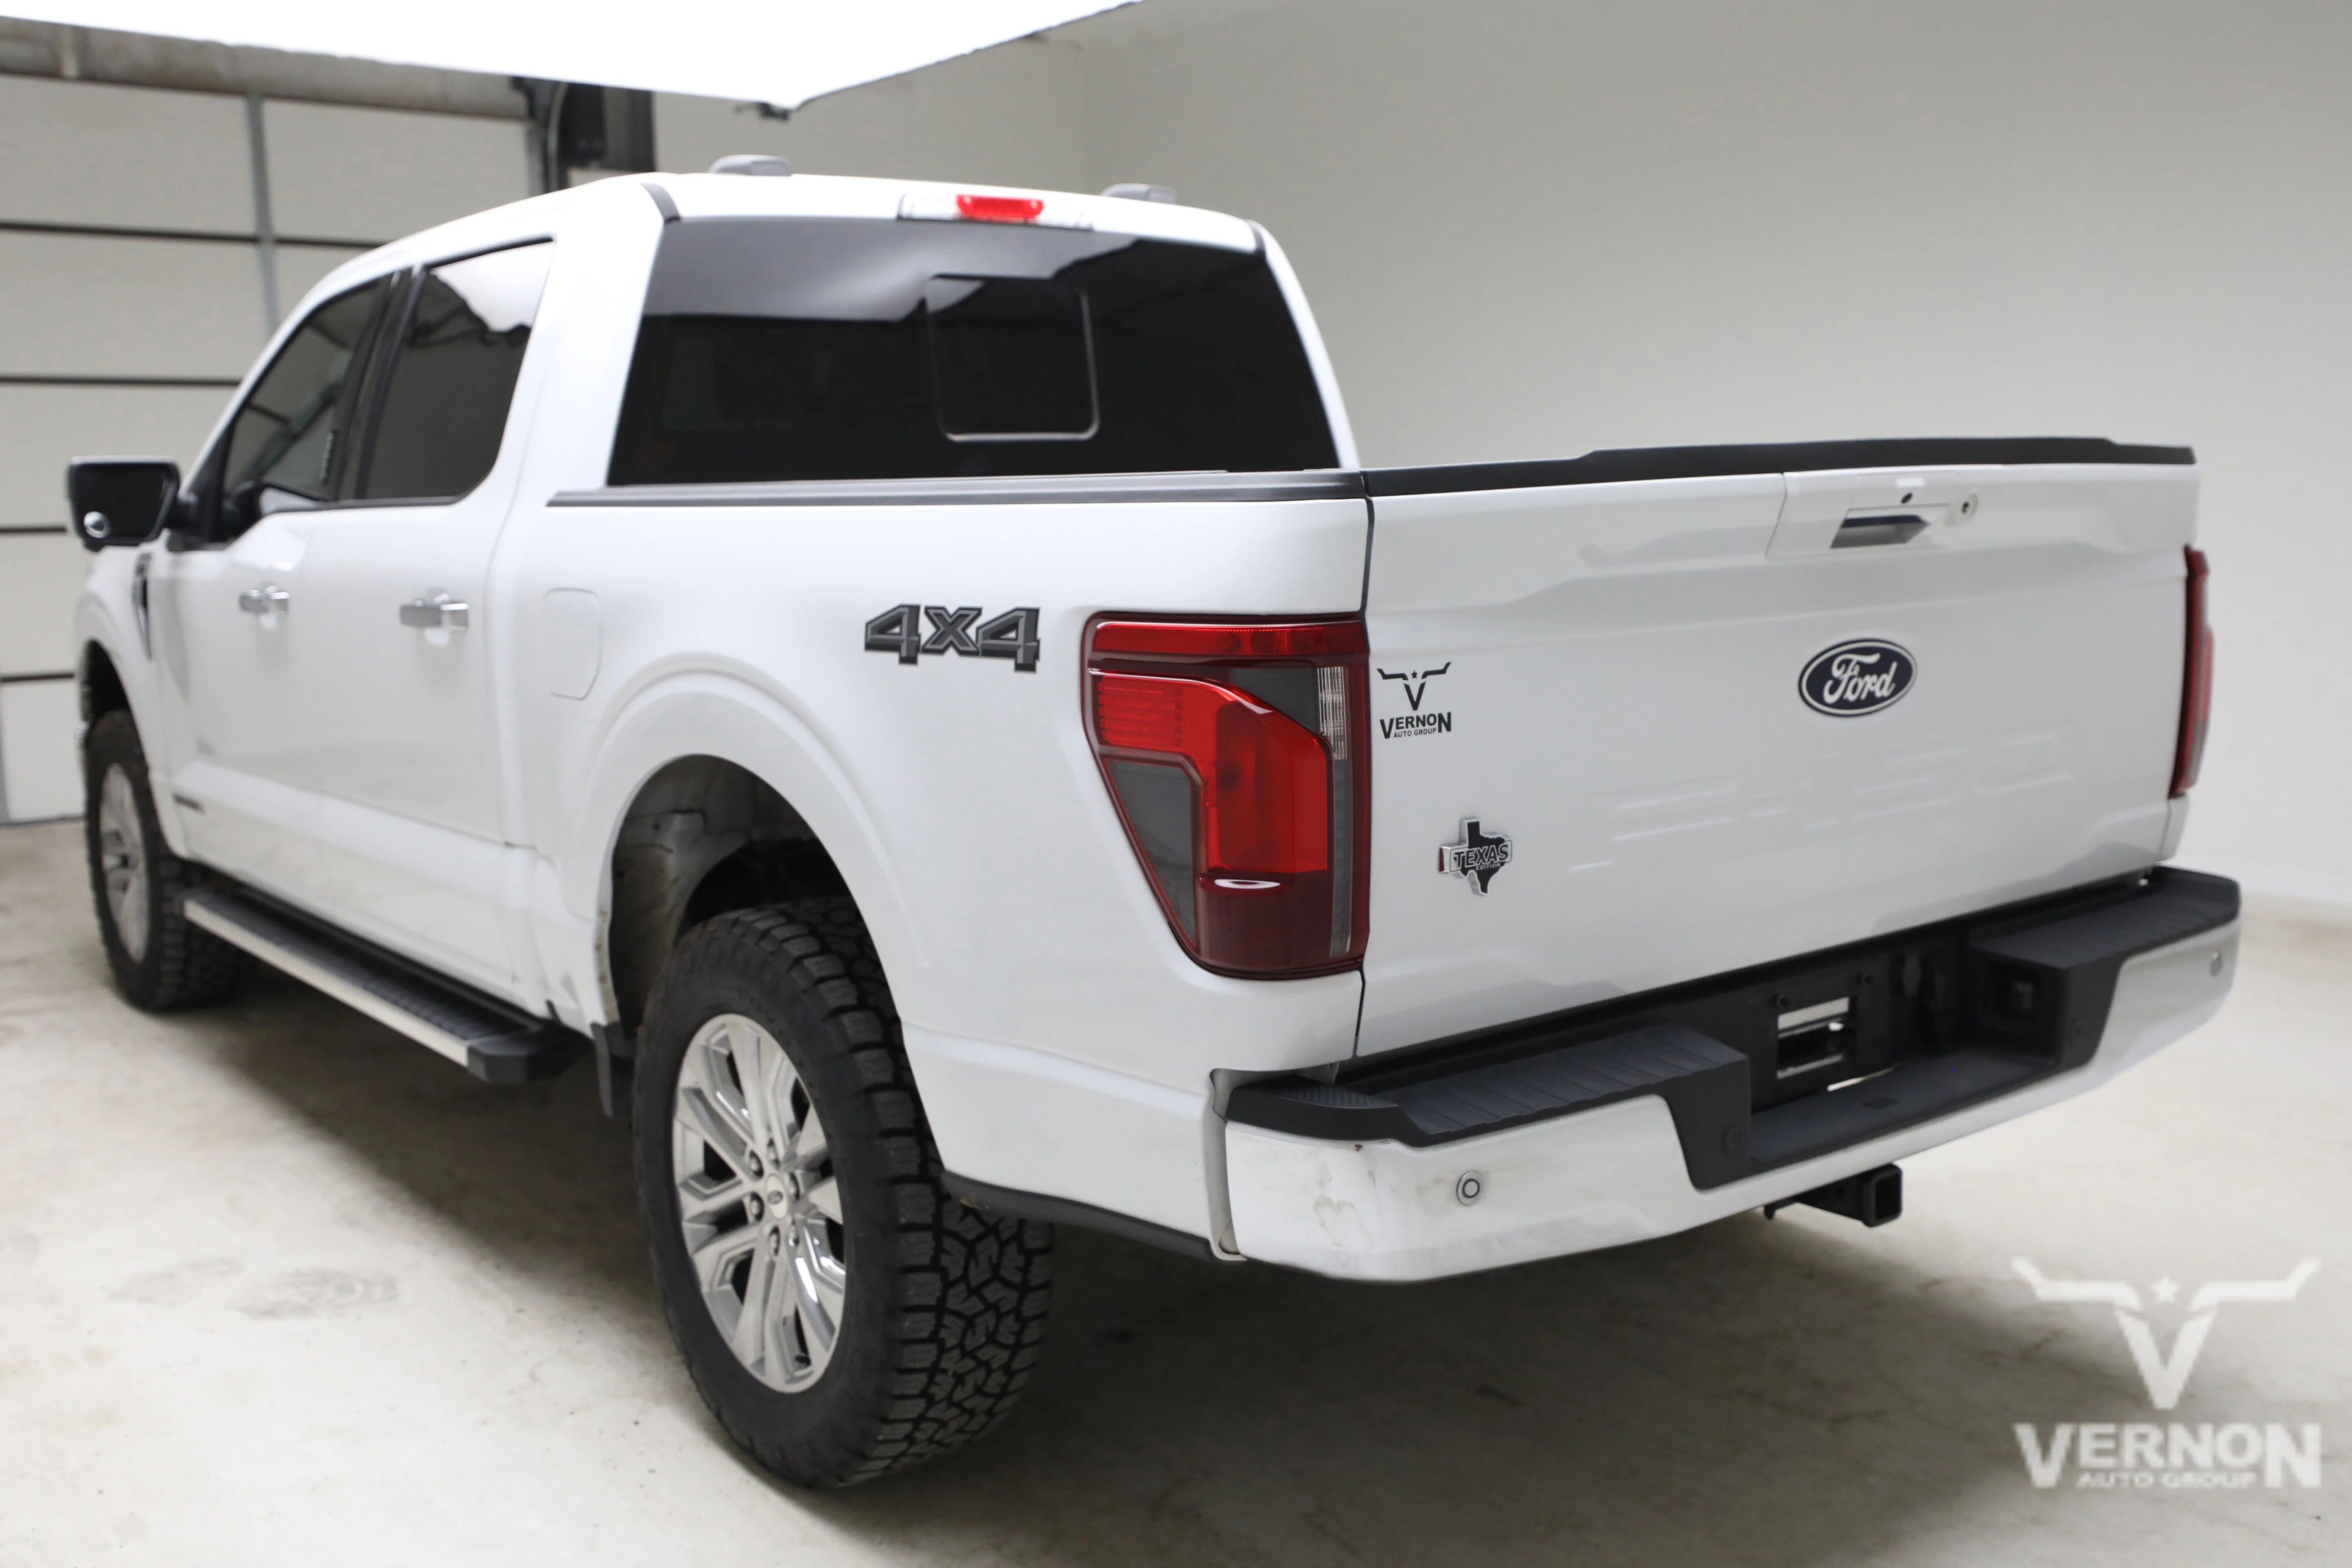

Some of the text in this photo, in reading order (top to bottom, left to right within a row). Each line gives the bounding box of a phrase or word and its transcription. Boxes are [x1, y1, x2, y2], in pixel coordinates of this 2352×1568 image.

[1823, 653, 1898, 704] Ford
[1379, 712, 1451, 739] VERNON
[1393, 727, 1437, 738] AUTO GROUP
[1454, 844, 1509, 868] TEXAS
[1476, 862, 1501, 871] EDITION
